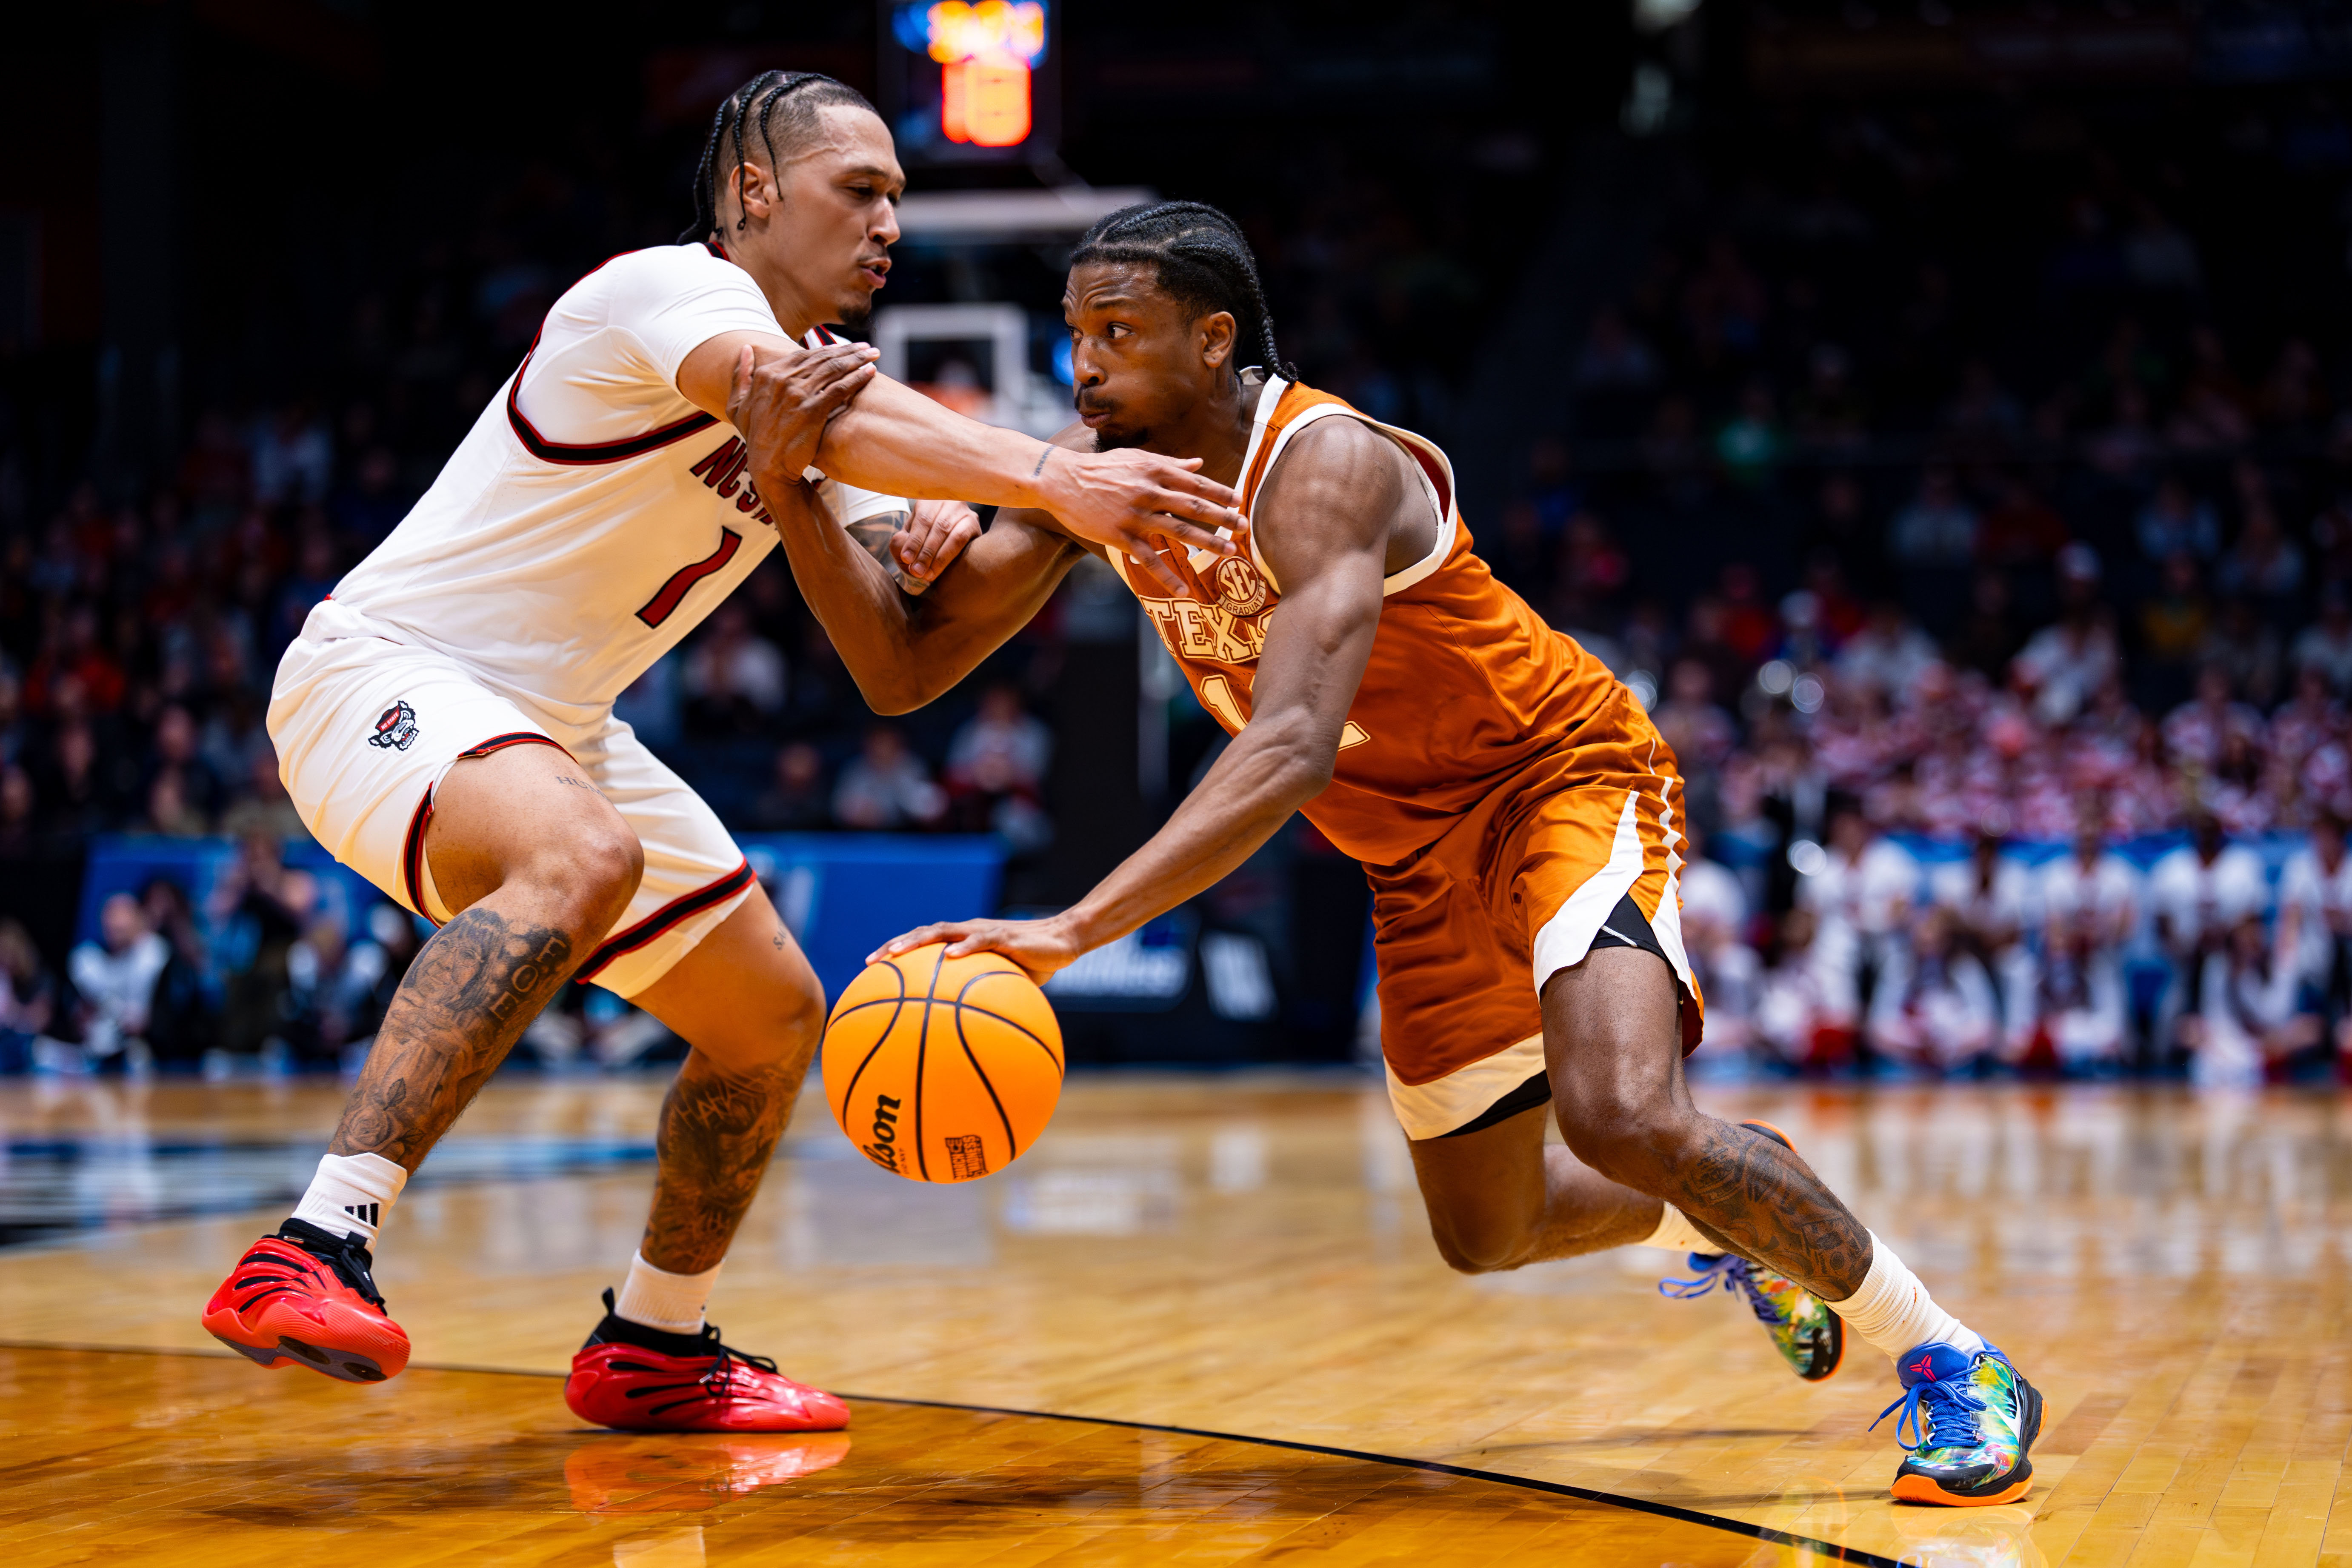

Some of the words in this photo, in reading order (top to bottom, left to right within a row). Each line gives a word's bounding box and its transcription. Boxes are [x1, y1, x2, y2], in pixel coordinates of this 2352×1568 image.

[634, 526, 743, 629] 1
[1220, 560, 1256, 601] SEC
[1226, 591, 1265, 615] GRADUATE
[1138, 594, 1275, 664] TEX
[381, 722, 388, 730] NC
[387, 711, 399, 725] STATE
